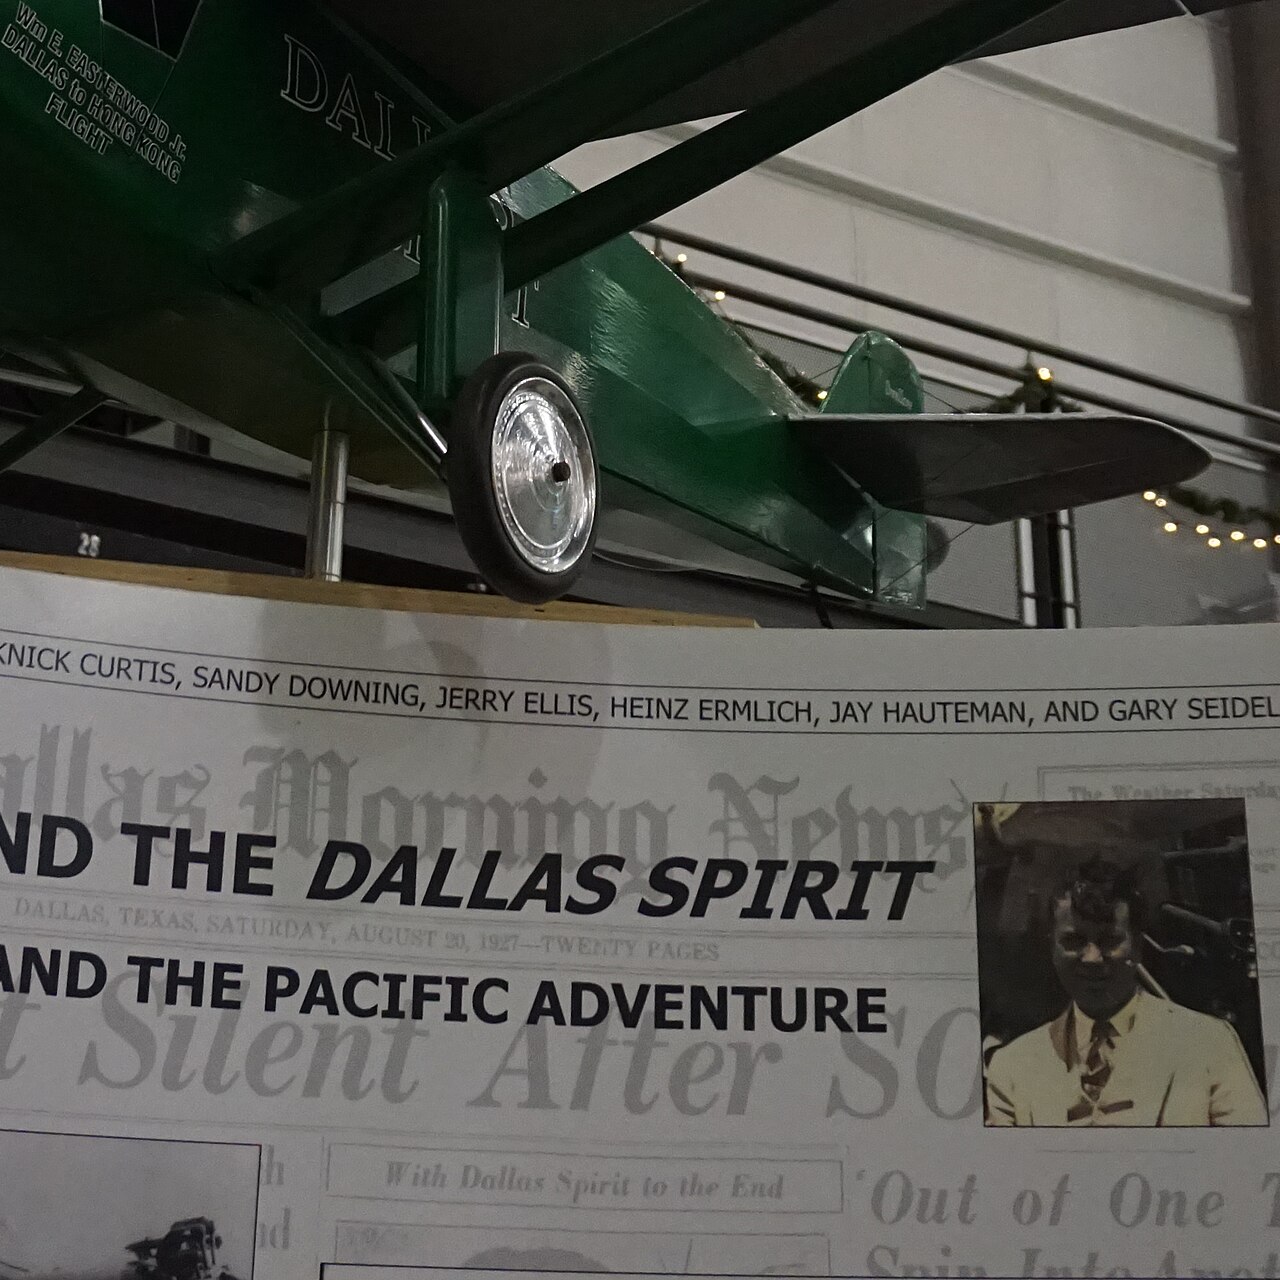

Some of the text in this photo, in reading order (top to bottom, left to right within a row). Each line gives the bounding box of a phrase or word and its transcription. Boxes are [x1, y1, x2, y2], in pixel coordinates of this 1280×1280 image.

[1, 24, 182, 183] DALLAS to HONG KONG
[16, 0, 187, 162] Wm E. EASTERWOOD Jr.
[45, 92, 113, 155] FLIGHT
[80, 653, 182, 690] CURTIS,
[193, 666, 280, 695] SANDY
[289, 675, 426, 711] DOWNING,
[436, 686, 515, 712] JERRY
[524, 692, 600, 721] ELLIS,
[611, 697, 689, 720] HEINZ
[699, 699, 820, 727] ERMLICH,
[830, 701, 872, 723] JAY
[883, 700, 1034, 726] HAUTEMAN,
[1045, 700, 1099, 722] AND
[1109, 698, 1178, 721] GARY
[1188, 696, 1280, 718] SEIDEL
[121, 823, 276, 897] THE
[306, 840, 624, 917] DALLAS
[636, 856, 936, 921] SPIRIT
[348, 923, 437, 949] AUGUST
[127, 956, 244, 1010] THE
[264, 967, 509, 1024] PACIFIC
[526, 980, 888, 1035] ADVENTURE
[77, 970, 429, 1104] Silent
[826, 1004, 982, 1120] SO
[386, 1160, 447, 1189] With
[642, 1173, 668, 1198] to
[680, 1173, 720, 1199] the
[730, 1173, 785, 1201] End
[1012, 1173, 1071, 1227] of
[1110, 1171, 1225, 1228] One
